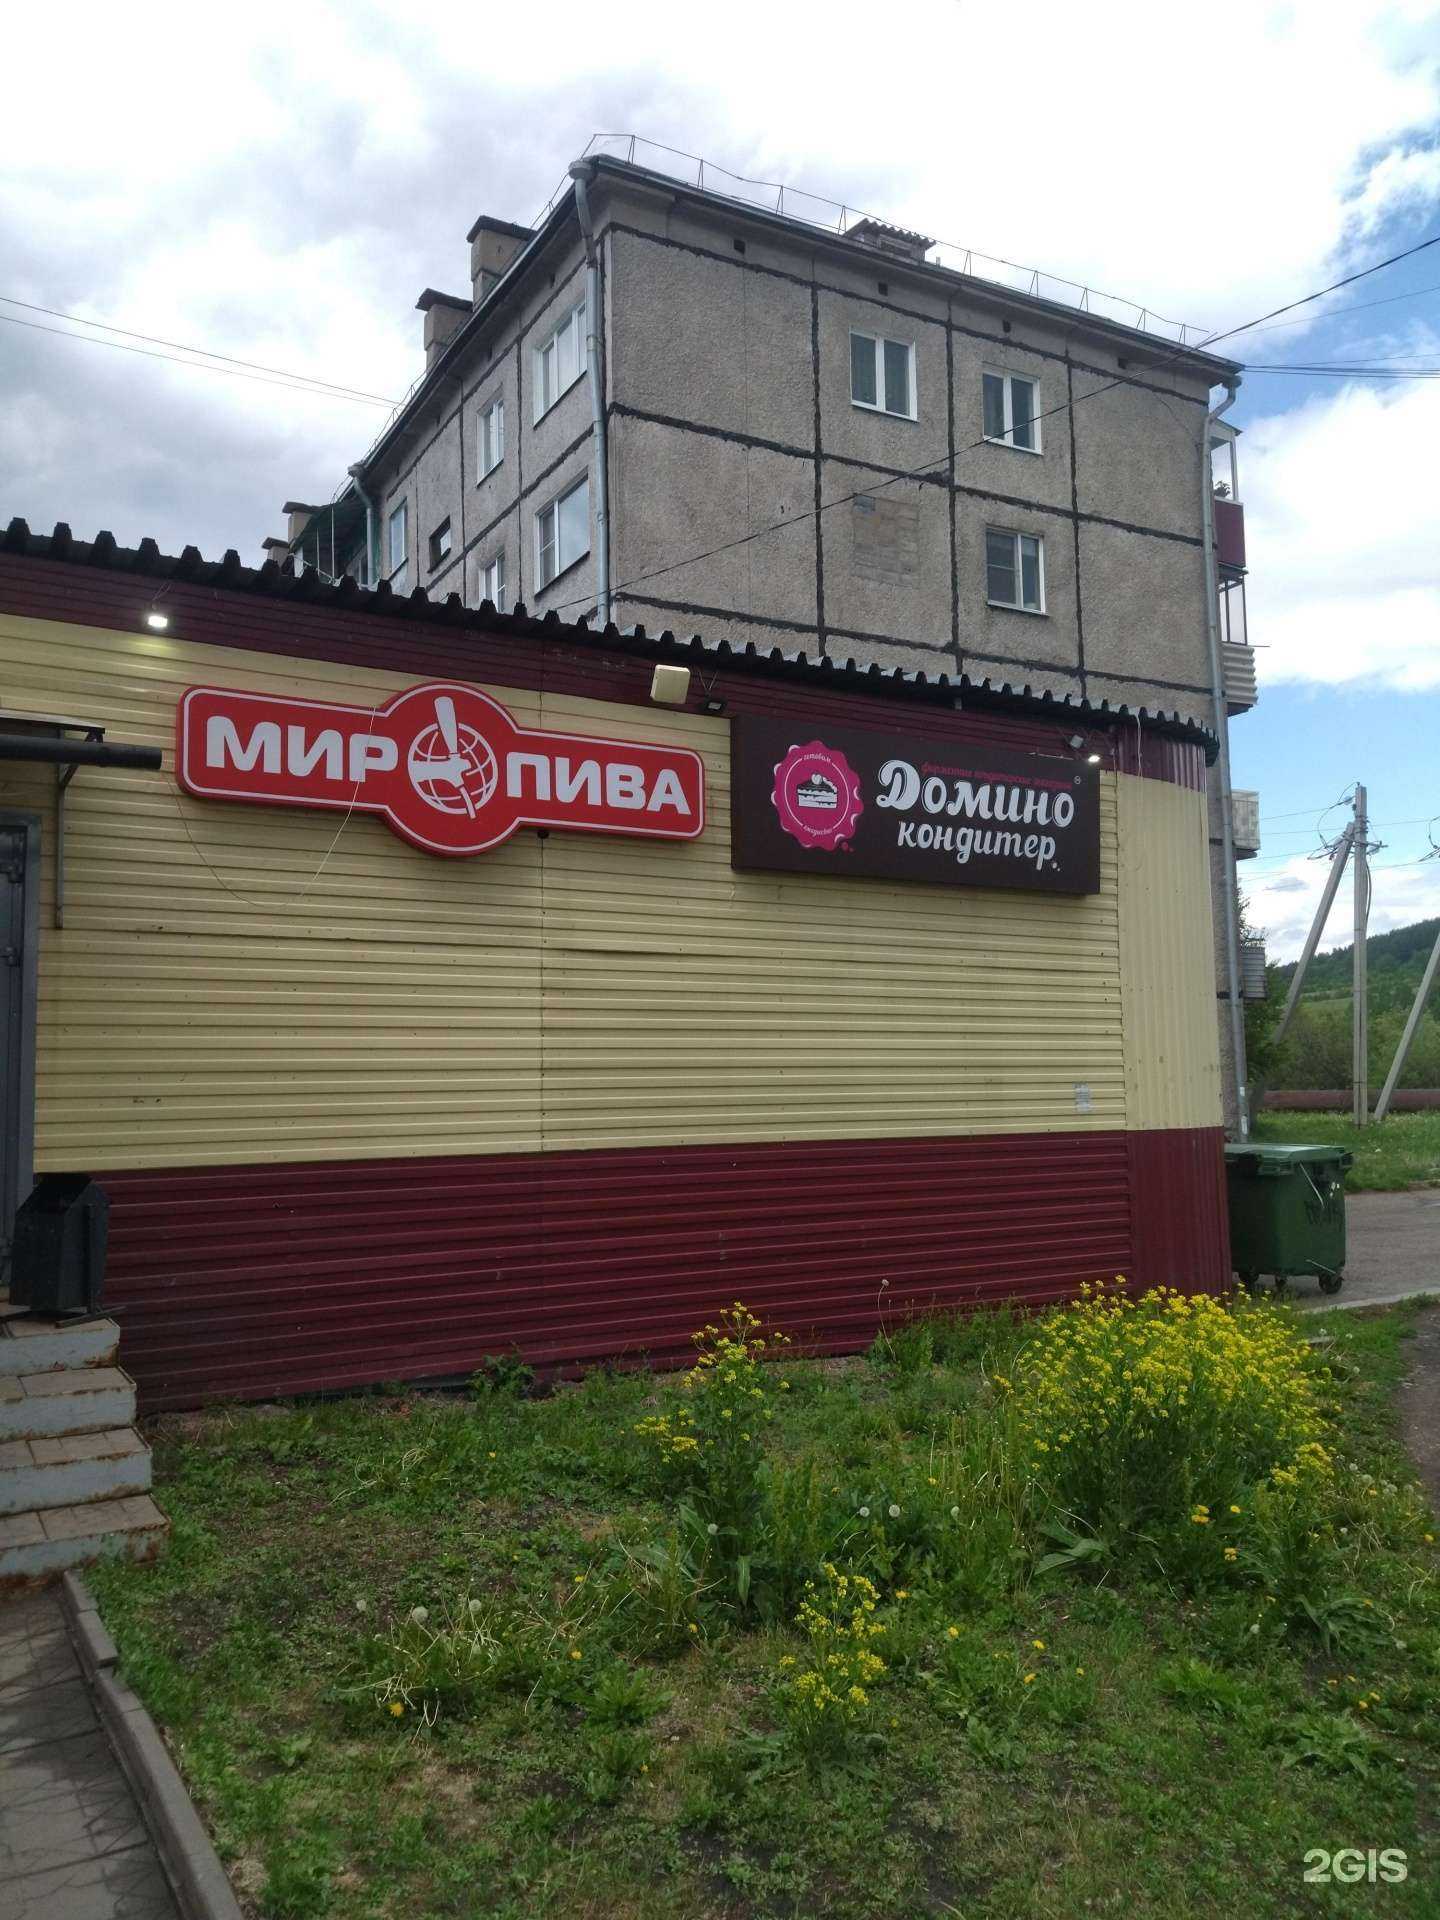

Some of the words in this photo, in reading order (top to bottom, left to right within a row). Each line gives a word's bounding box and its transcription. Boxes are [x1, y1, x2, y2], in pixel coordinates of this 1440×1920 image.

[206, 715, 399, 783] МИР
[506, 751, 692, 815] ПИВА
[876, 760, 1074, 828] Домино
